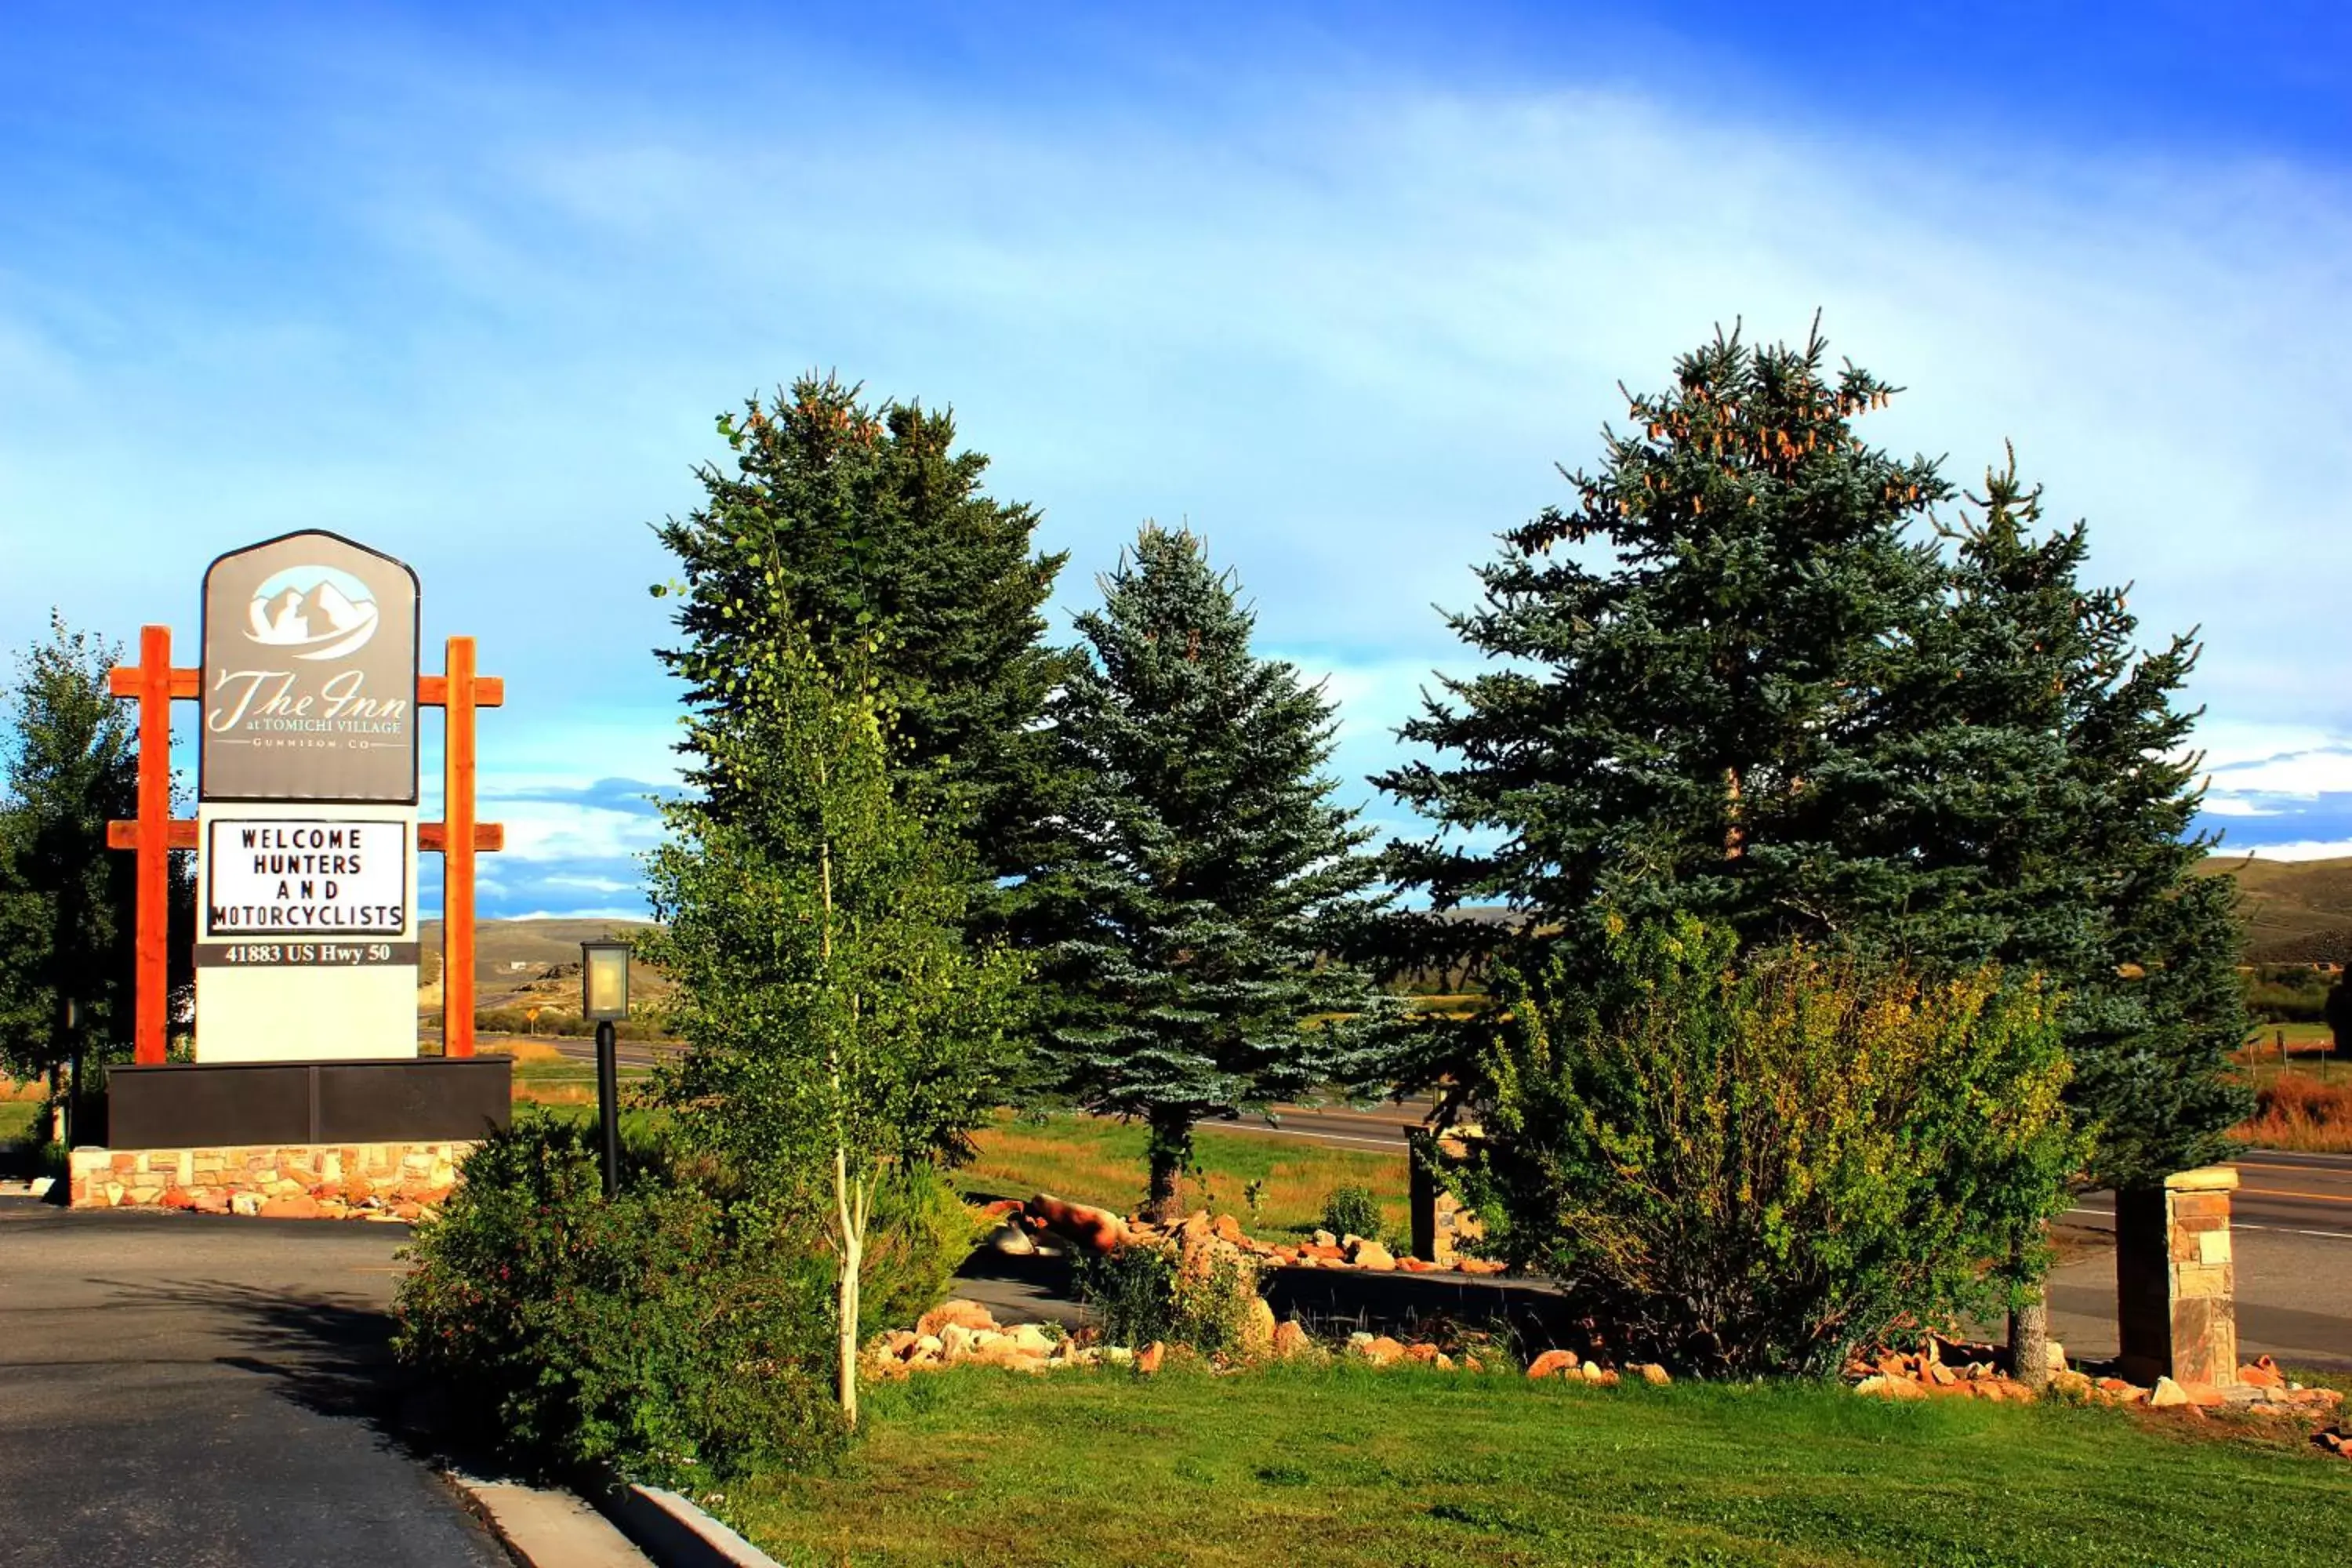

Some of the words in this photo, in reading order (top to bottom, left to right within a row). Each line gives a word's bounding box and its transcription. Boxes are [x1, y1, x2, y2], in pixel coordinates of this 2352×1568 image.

[209, 670, 314, 732] The
[321, 670, 406, 719] Inn
[246, 720, 260, 730] at
[263, 718, 332, 731] TOMICHI
[337, 720, 401, 733] VILLAGE
[349, 740, 369, 749] CO
[242, 829, 361, 849] WELCOME
[254, 855, 361, 874] HUNTERS
[277, 880, 338, 899] AND
[213, 906, 402, 926] MOTORCYCLISTS
[225, 946, 281, 962] 41883
[287, 946, 314, 961] US
[321, 946, 363, 964] Hwy
[368, 945, 390, 960] 50
